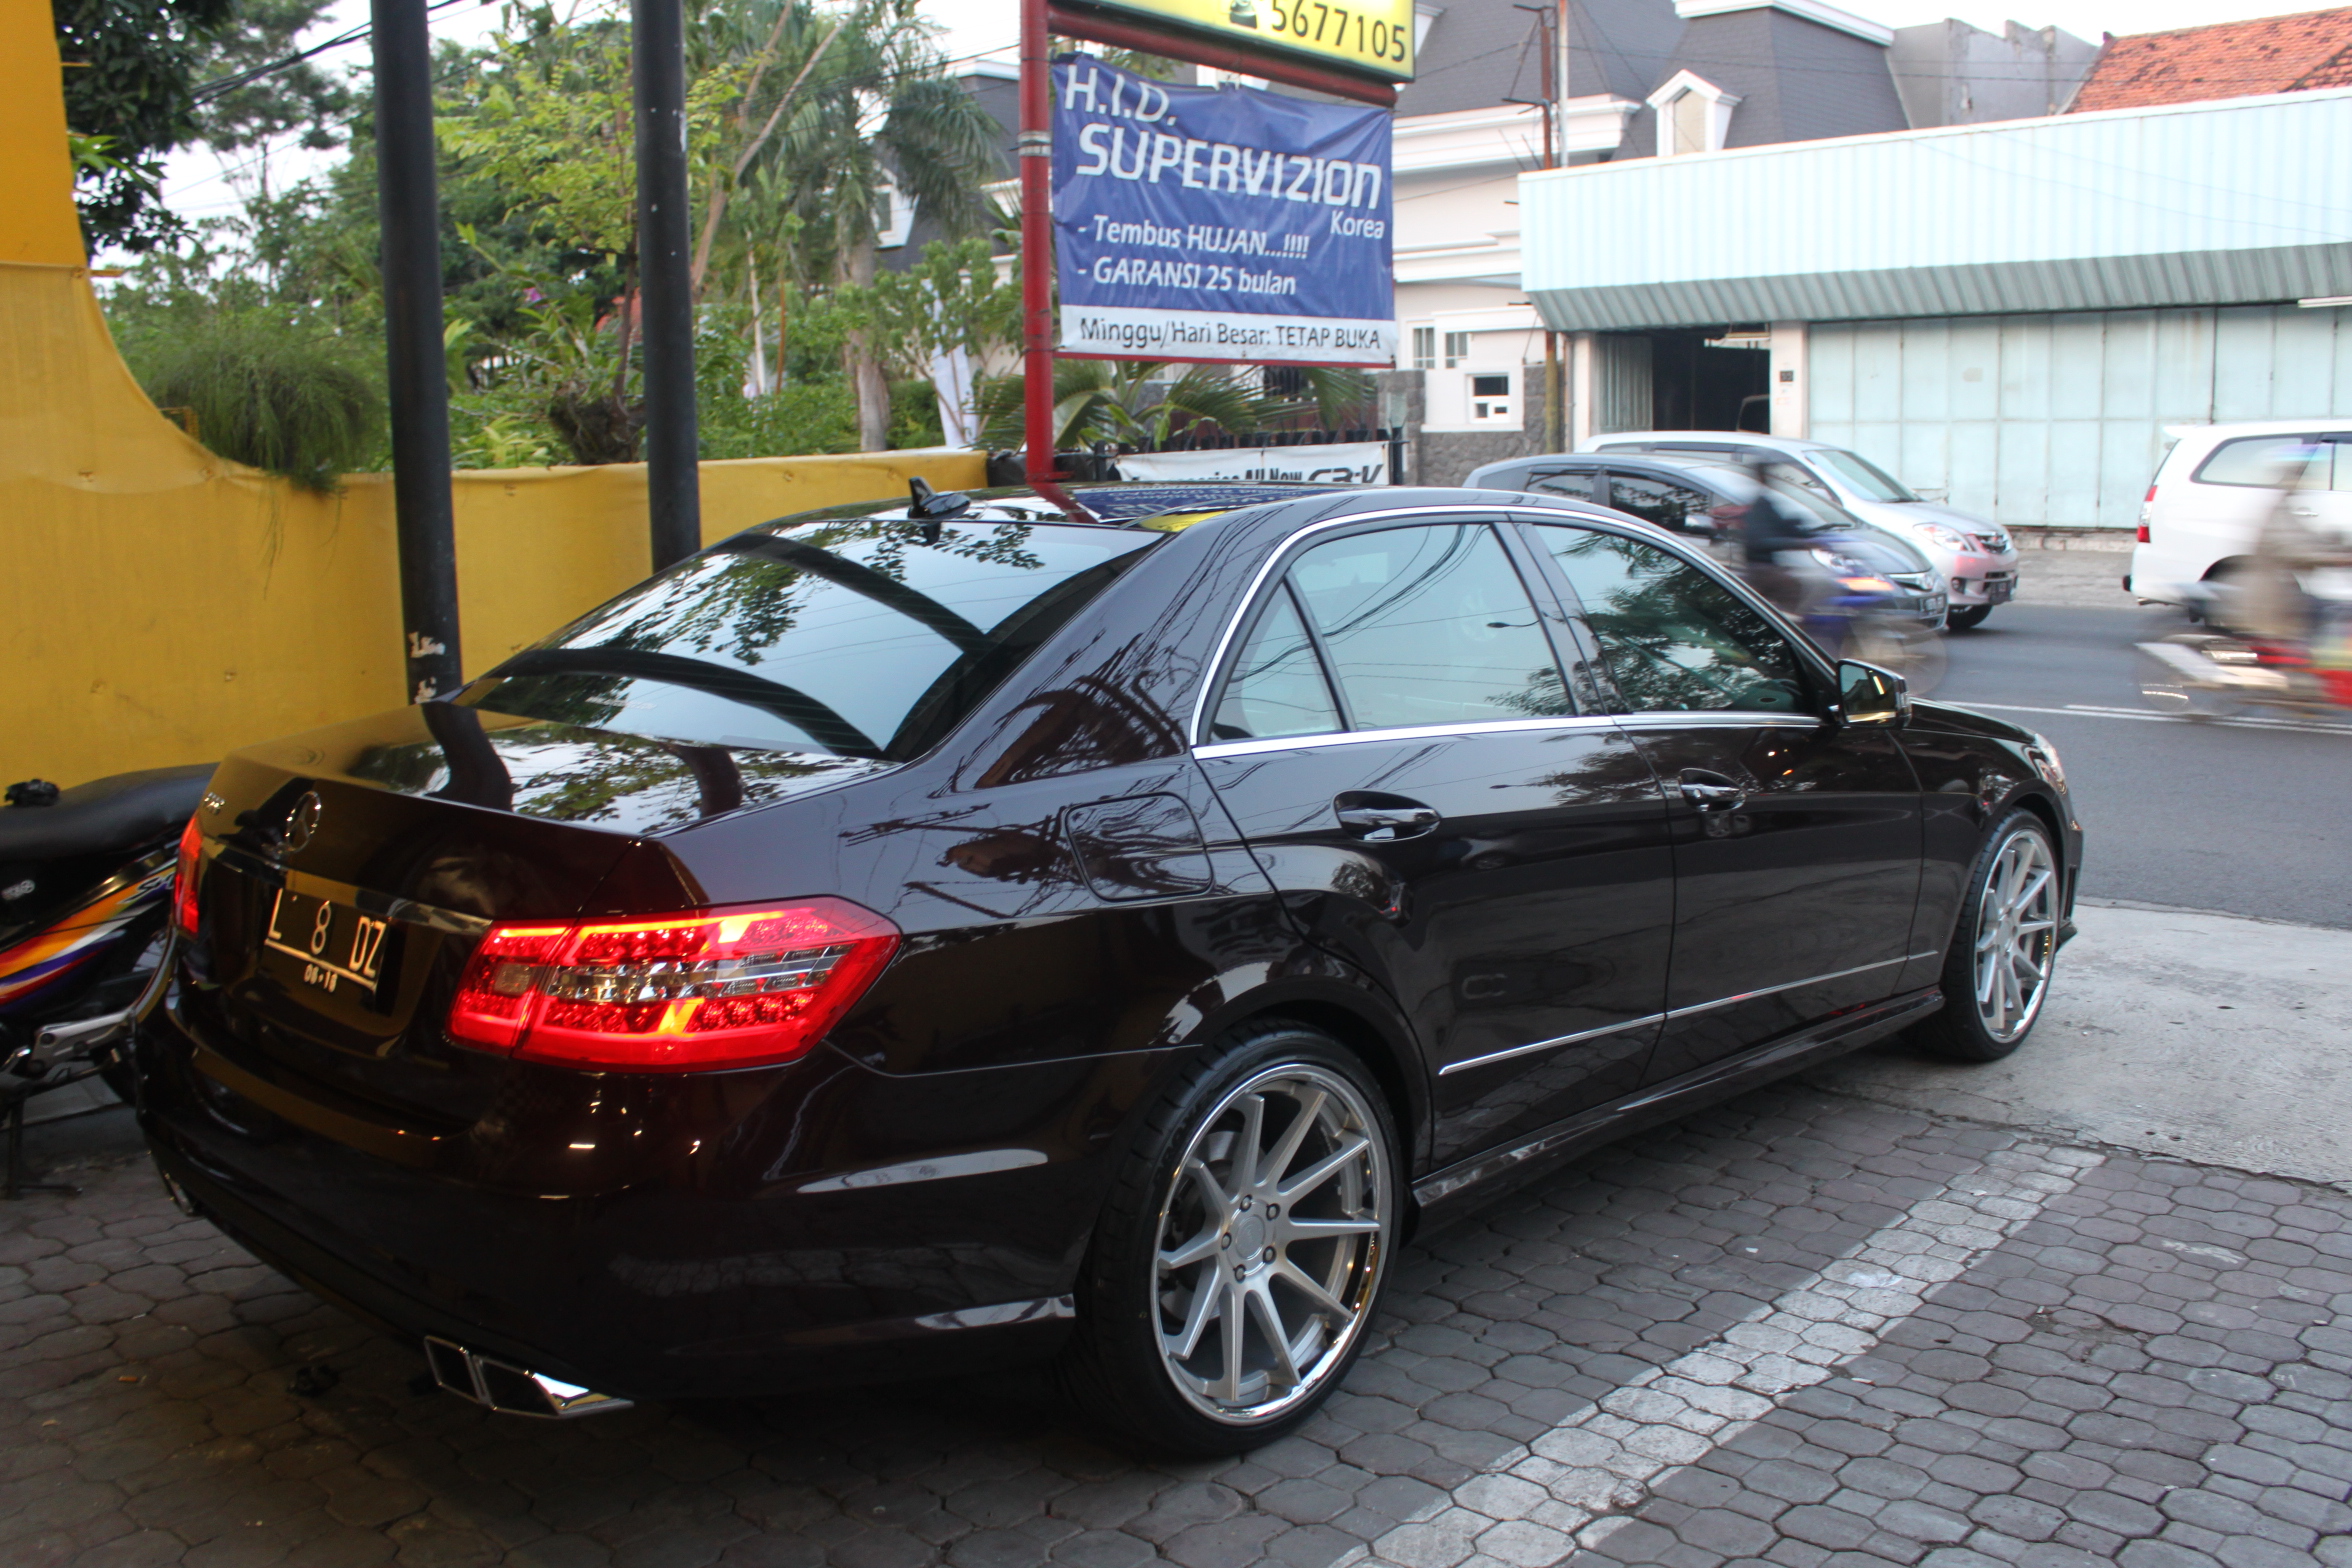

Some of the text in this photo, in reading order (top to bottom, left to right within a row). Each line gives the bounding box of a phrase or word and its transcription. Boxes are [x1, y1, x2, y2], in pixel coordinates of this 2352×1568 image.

[1272, 0, 1405, 62] 5677105
[1065, 64, 1177, 126] H.I.D.
[1094, 214, 1181, 248] Tembus
[1330, 210, 1385, 239] Korea
[1093, 256, 1201, 289] GARANSI
[1205, 265, 1233, 291] 25
[1238, 268, 1296, 295] bulan
[1080, 318, 1381, 349] Minggu/Hari Besar: TETAP BUKA
[268, 887, 282, 940] L
[310, 900, 332, 955] 8
